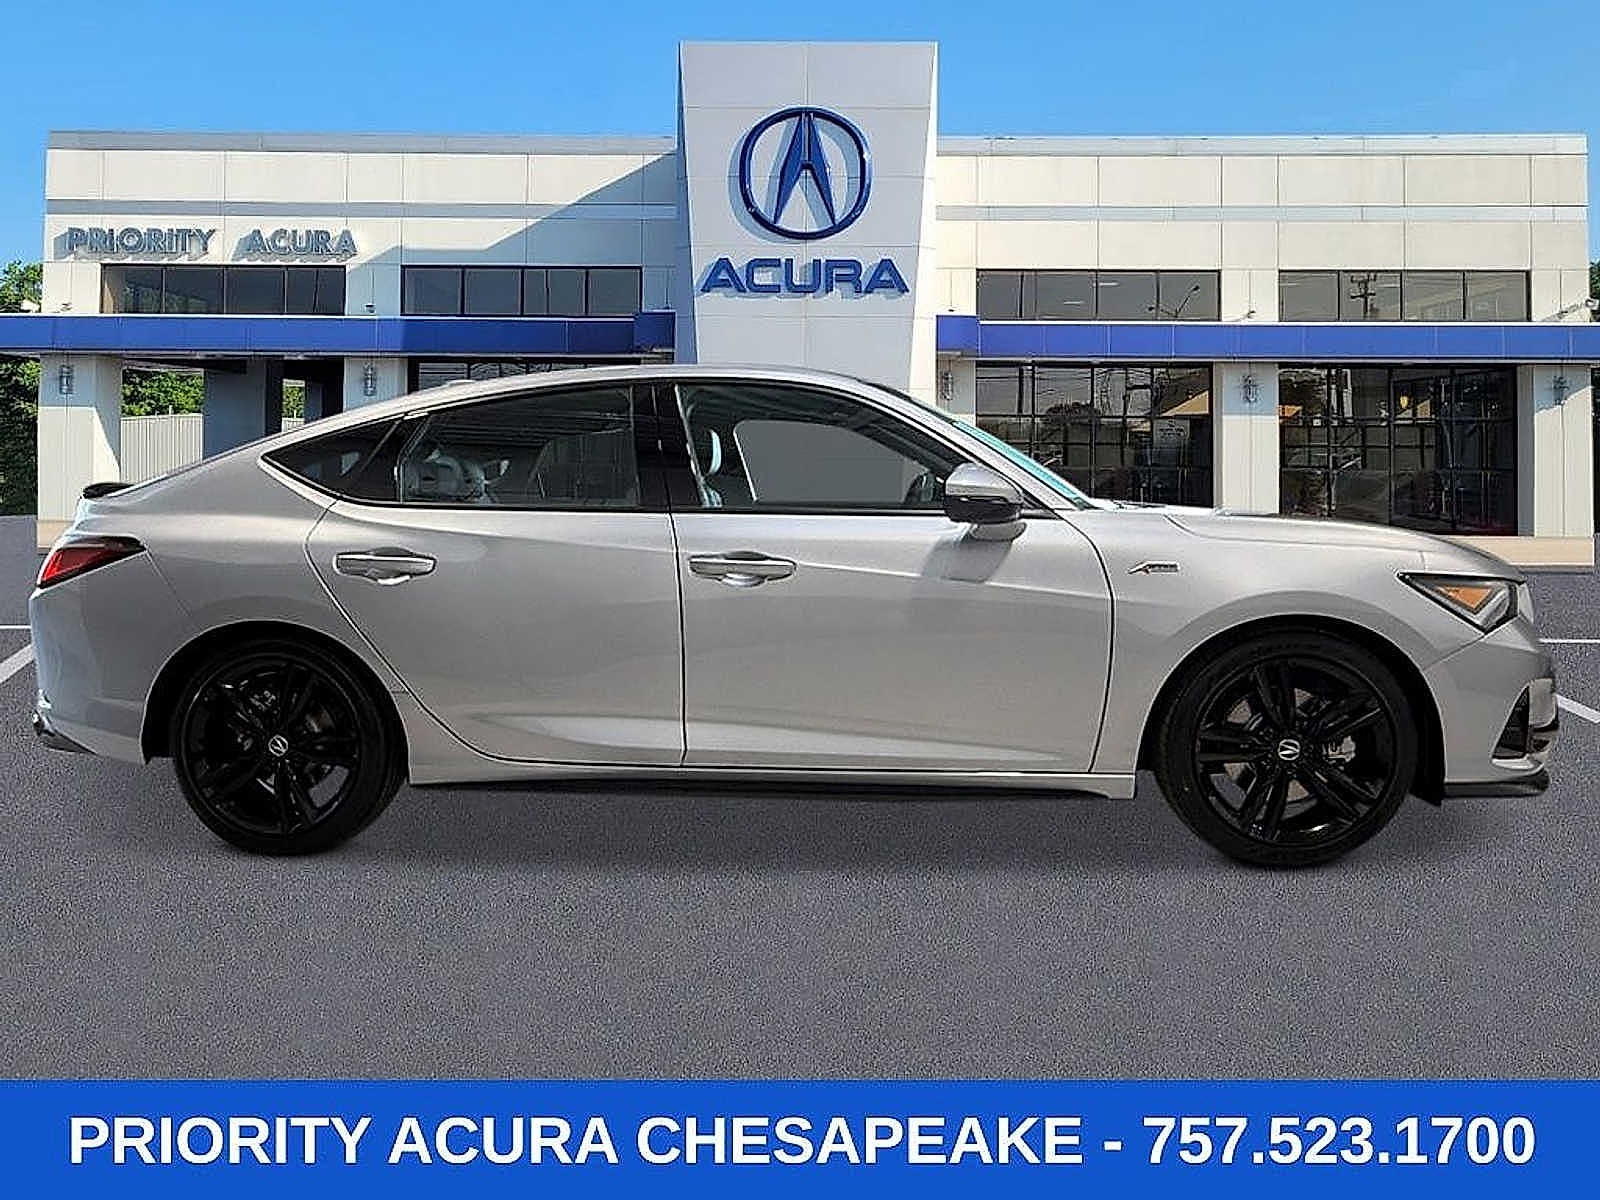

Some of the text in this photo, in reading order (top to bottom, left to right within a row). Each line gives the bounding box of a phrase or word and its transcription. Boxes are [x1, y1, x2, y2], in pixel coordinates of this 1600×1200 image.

[67, 226, 358, 256] PRIORITY ACURA
[701, 257, 909, 294] ACURA
